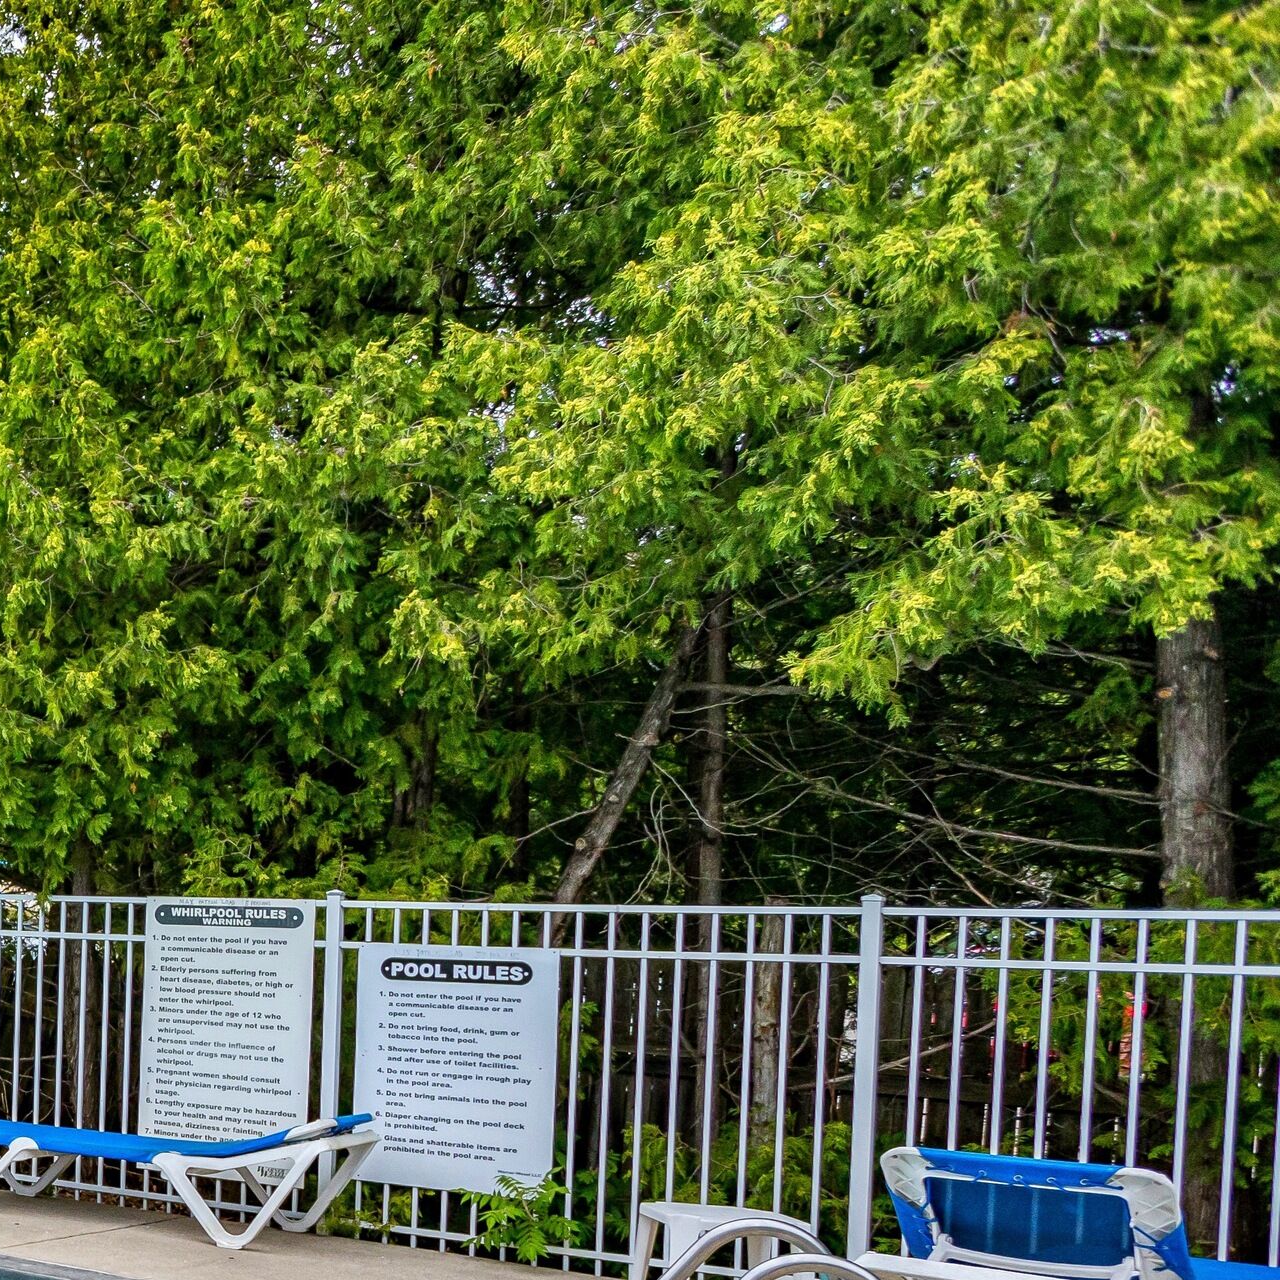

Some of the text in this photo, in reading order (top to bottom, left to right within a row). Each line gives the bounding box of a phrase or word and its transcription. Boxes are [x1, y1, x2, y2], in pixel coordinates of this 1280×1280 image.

[171, 907, 287, 920] WHIRLPOOL RULES
[202, 917, 252, 926] WARNING
[160, 965, 186, 974] Elderly
[222, 969, 256, 977] suffering
[391, 962, 524, 981] POOL RULES
[265, 981, 283, 989] high
[159, 1006, 184, 1014] Minors
[417, 1025, 437, 1033] bring
[449, 1051, 484, 1059] entering
[156, 1067, 190, 1076] Pregnant
[442, 1073, 473, 1081] engage
[513, 1078, 532, 1086] play
[175, 1080, 211, 1089] physician
[214, 1084, 252, 1094] regarding
[254, 1087, 292, 1096] whirlpool
[414, 1093, 435, 1101] bring
[385, 1112, 411, 1120] Diaper
[414, 1115, 451, 1125] changing
[384, 1135, 406, 1143] Glass
[427, 1140, 474, 1149] shatterable
[477, 1144, 501, 1152] items
[384, 1146, 425, 1154] prohibited
